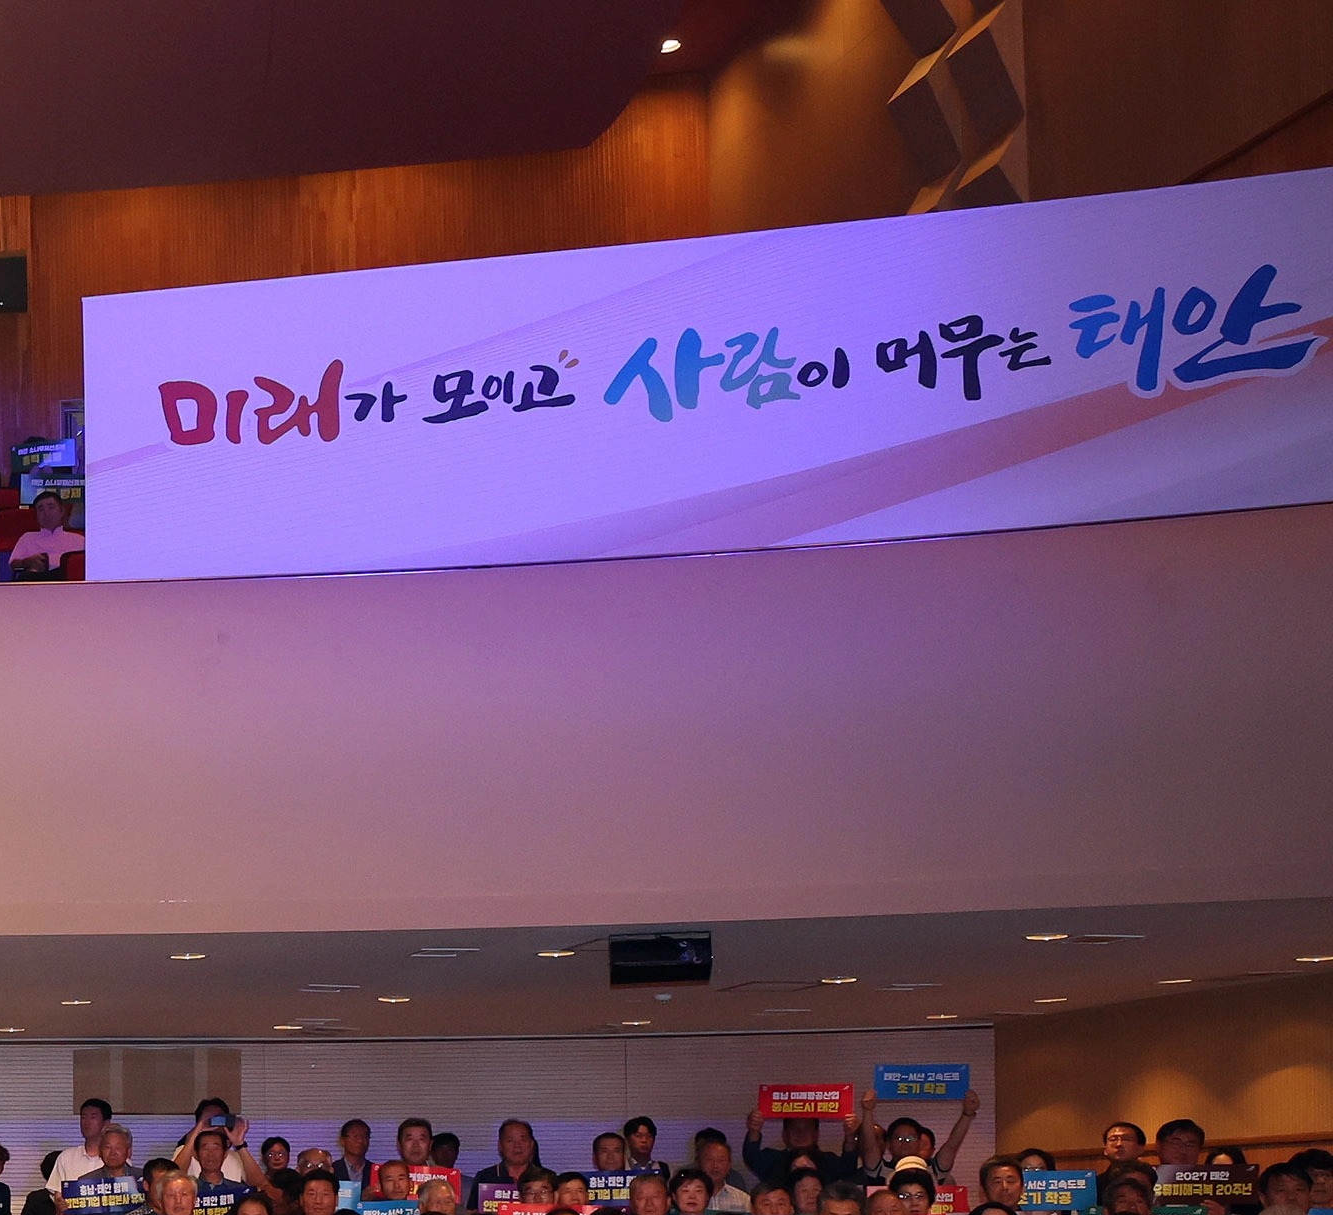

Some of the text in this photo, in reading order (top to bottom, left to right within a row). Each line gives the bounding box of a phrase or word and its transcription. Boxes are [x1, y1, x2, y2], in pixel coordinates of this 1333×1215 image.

[158, 263, 1331, 447] 미래가 모이고 사람이 머무는 태안
[1175, 1170, 1230, 1181] 2027 태안
[1216, 1183, 1252, 1196] 20주년
